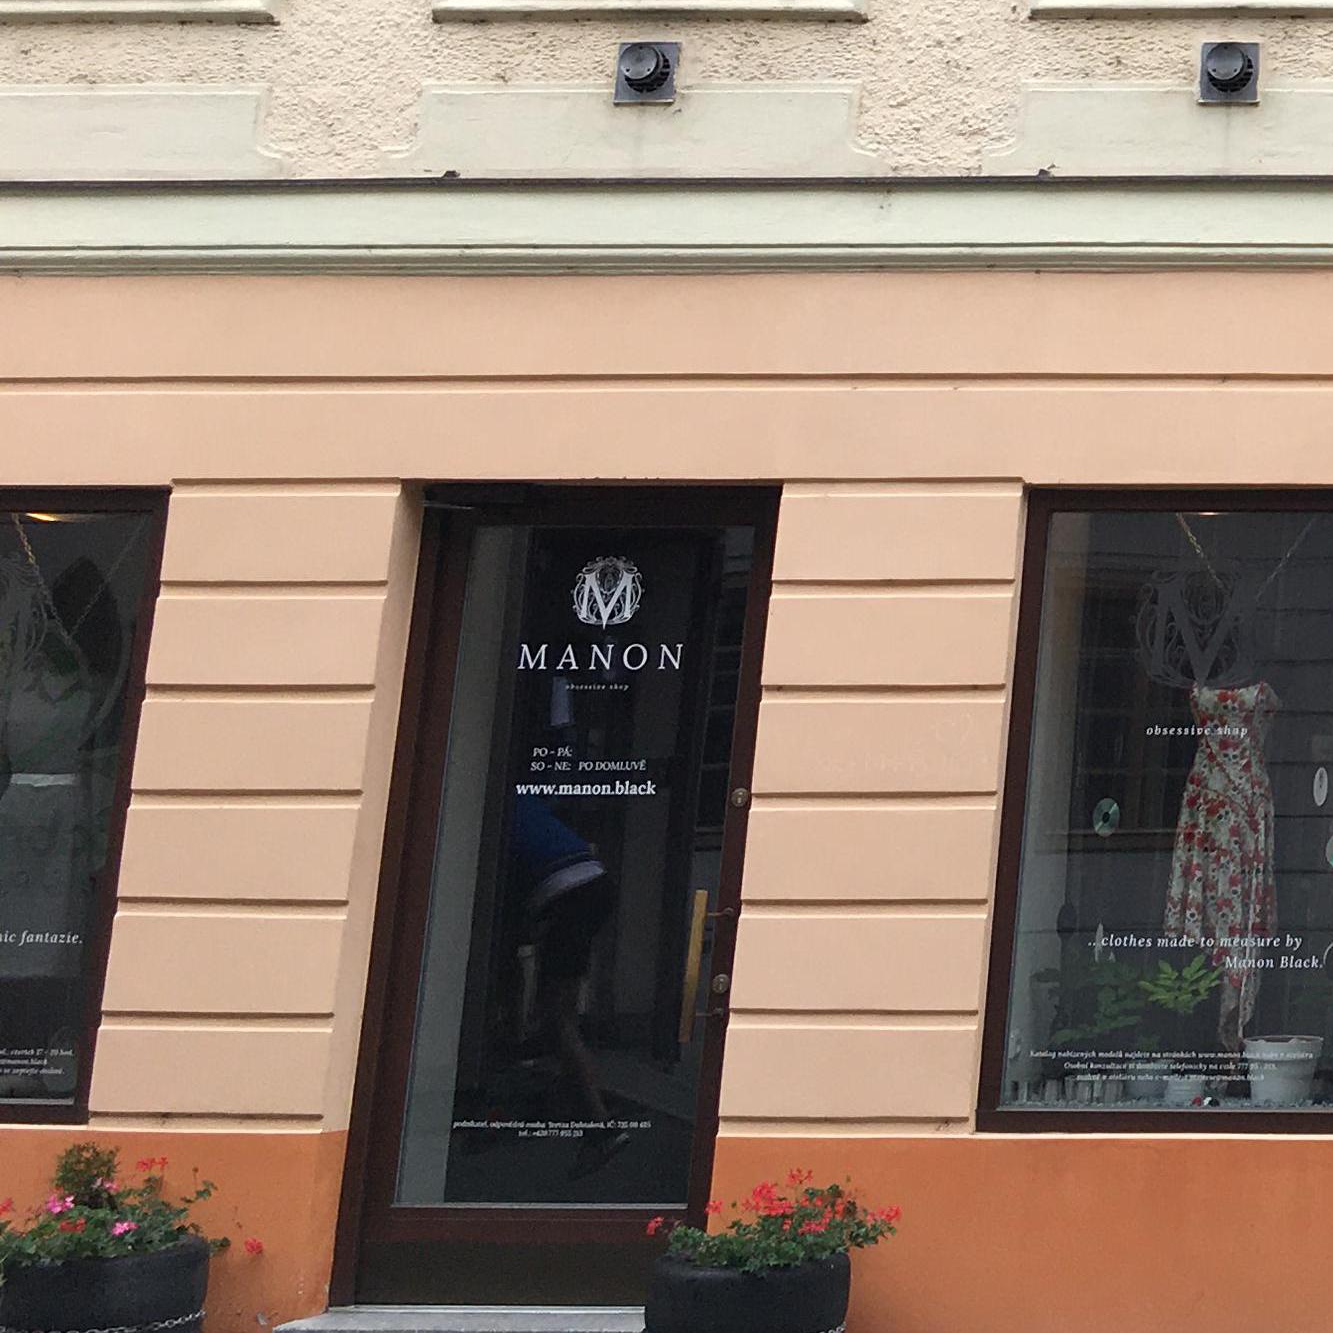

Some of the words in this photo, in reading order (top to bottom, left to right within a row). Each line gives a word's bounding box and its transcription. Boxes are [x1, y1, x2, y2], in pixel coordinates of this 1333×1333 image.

[517, 643, 684, 670] MANON
[1146, 725, 1211, 736] obsessive
[533, 747, 548, 757] PO
[530, 761, 545, 770] SO
[516, 780, 656, 795] www.manon.black
[0, 930, 17, 943] ic
[18, 930, 83, 946] fantazie.
[1156, 934, 1199, 947] made
[1200, 936, 1215, 947] to
[1219, 936, 1280, 947] measure
[1286, 934, 1303, 951] by
[1225, 956, 1274, 968] Manon
[1280, 955, 1324, 968] Black.
